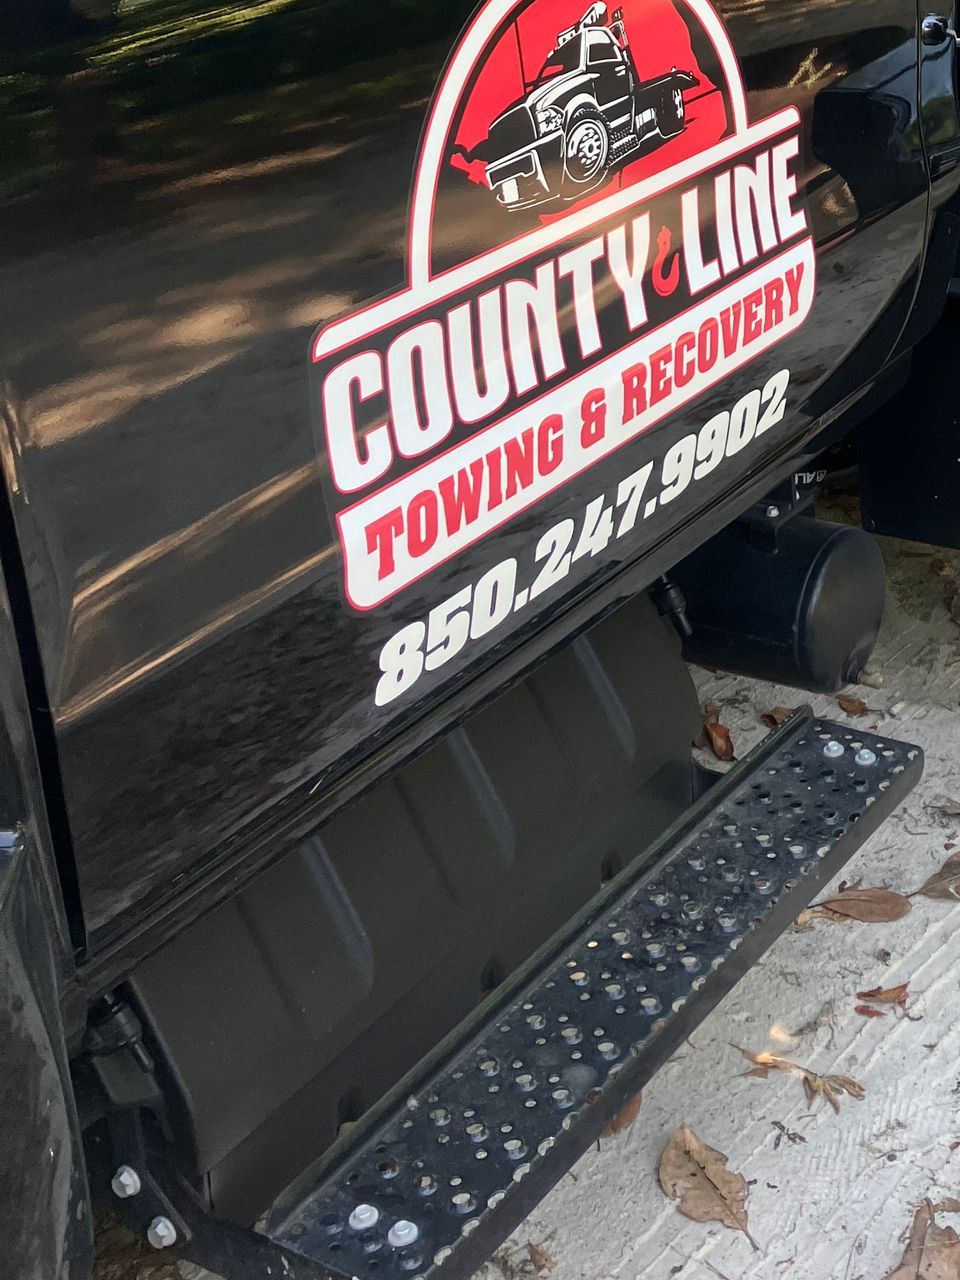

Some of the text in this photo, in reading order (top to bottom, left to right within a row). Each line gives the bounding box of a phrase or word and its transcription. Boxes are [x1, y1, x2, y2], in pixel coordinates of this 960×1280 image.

[322, 134, 808, 495] COUNTY LINE
[366, 262, 805, 581] TOWING & RECOVERY
[374, 368, 791, 707] 850.247.9902
